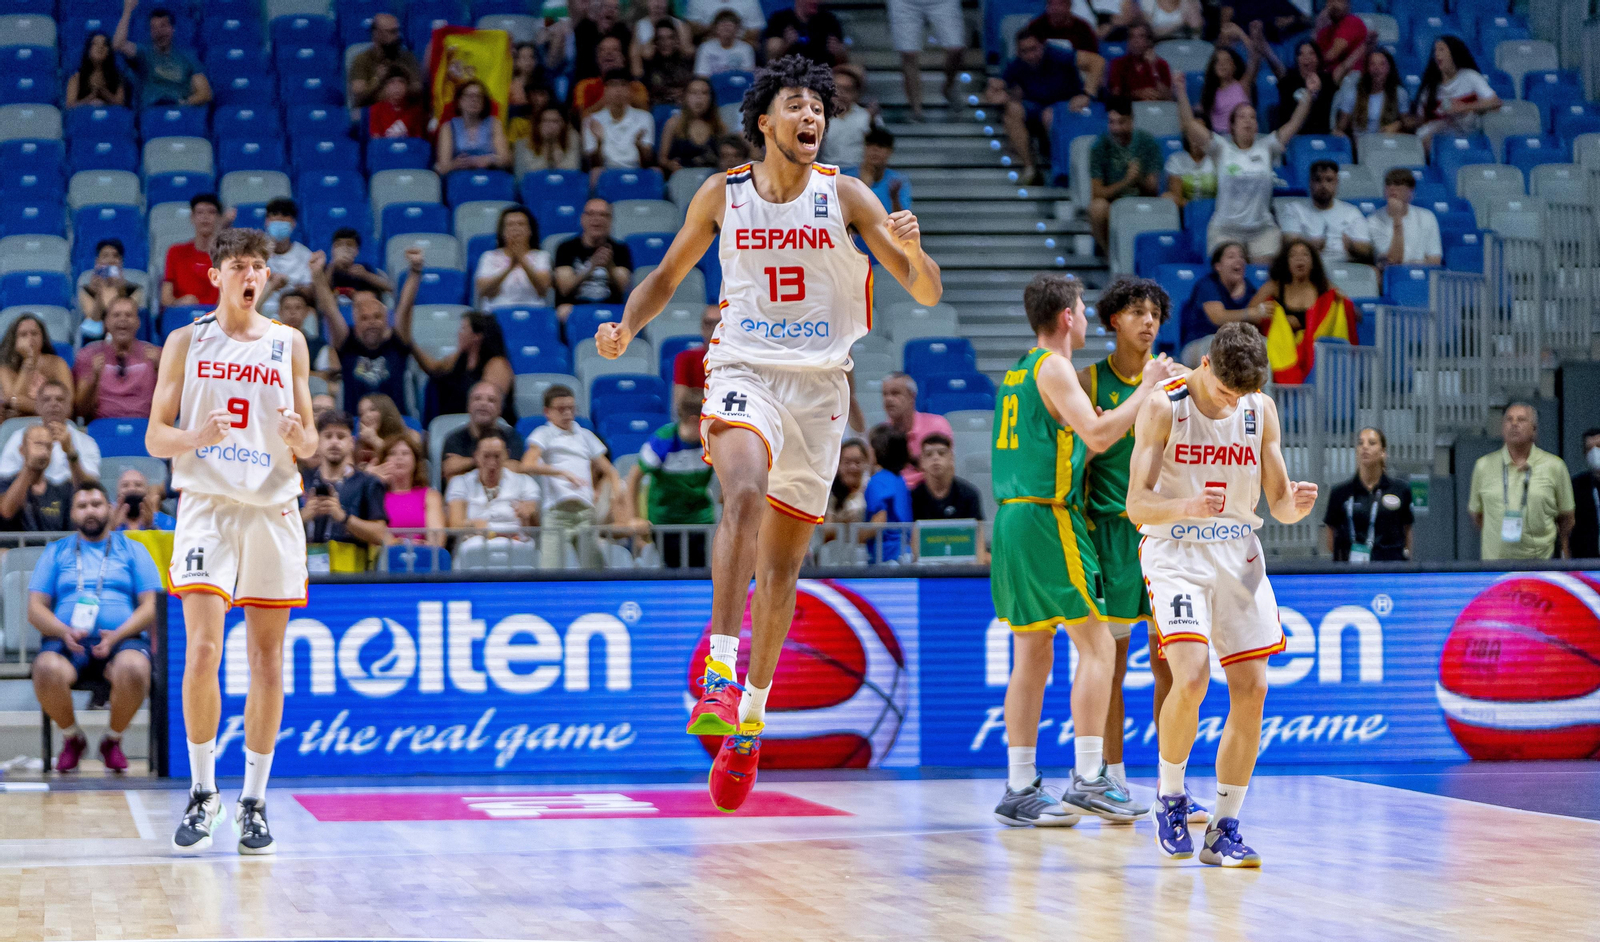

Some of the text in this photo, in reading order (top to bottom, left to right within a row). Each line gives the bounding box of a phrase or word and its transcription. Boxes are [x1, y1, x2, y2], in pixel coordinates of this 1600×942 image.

[735, 224, 835, 250] ESPAÑA
[763, 266, 806, 302] 13
[740, 318, 829, 338] endesa
[197, 360, 285, 389] ESPAÑA
[227, 397, 250, 429] 9
[996, 393, 1019, 450] 12
[195, 442, 271, 467] endesa
[1174, 442, 1257, 466] ESPAÑA
[1171, 522, 1252, 540] endesa
[224, 600, 633, 698] molten
[214, 707, 638, 770] Fr the real game
[970, 706, 1054, 752] Fr
